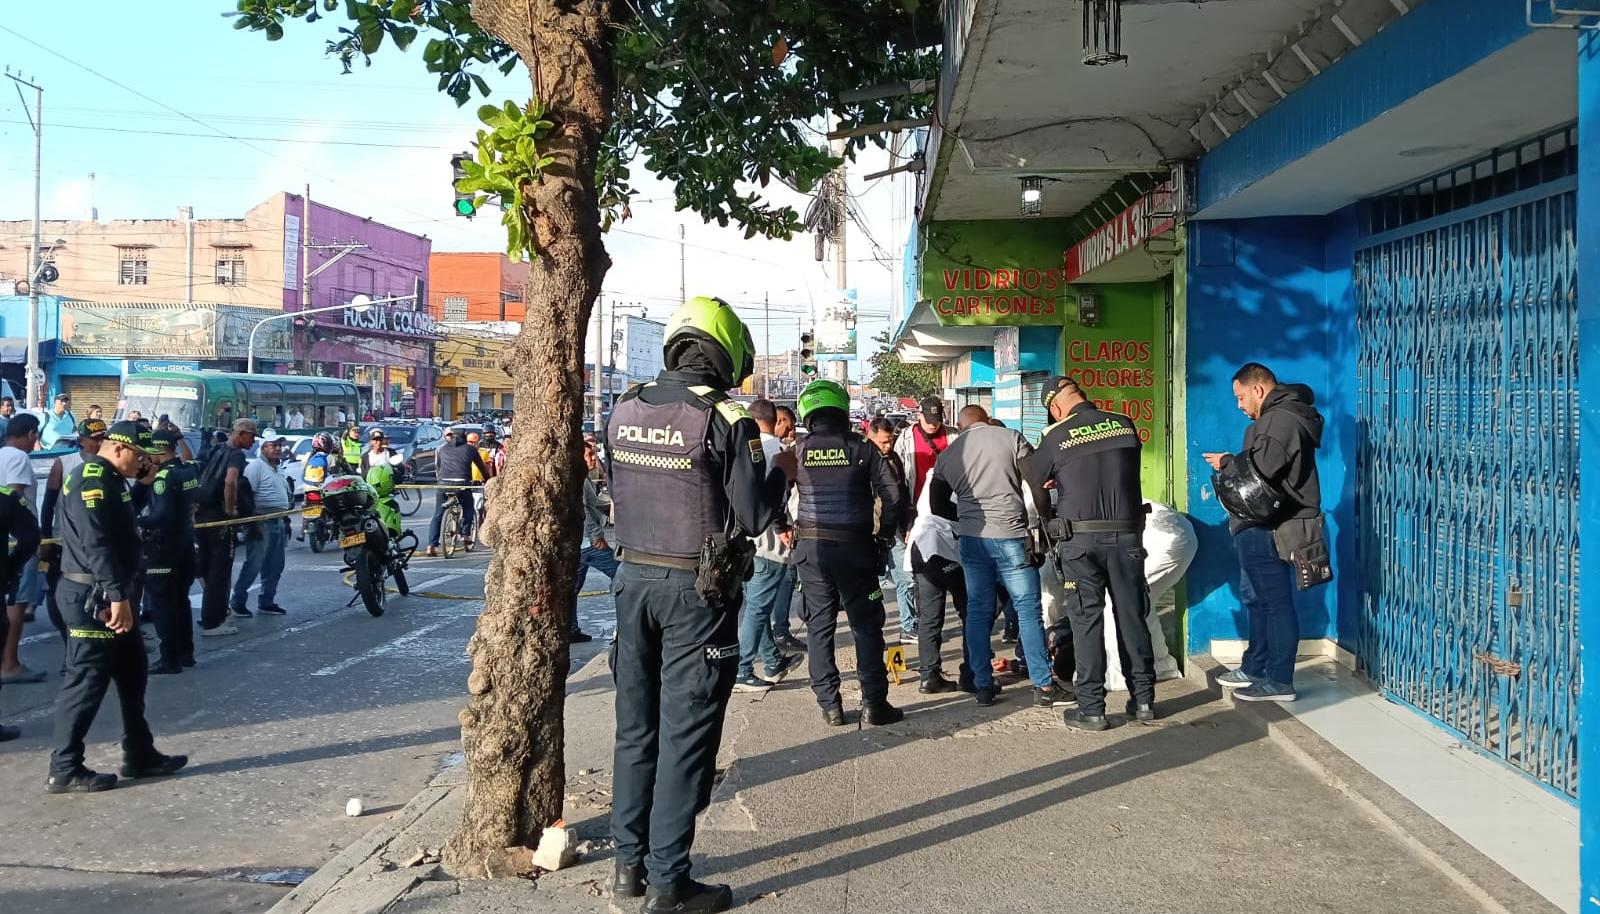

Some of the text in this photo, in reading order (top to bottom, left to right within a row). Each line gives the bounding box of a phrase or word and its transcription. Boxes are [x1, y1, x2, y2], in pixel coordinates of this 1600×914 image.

[1078, 223, 1113, 275] VIDRIOS
[1115, 212, 1128, 256] LA
[943, 268, 1059, 291] VIDRIOS
[343, 303, 387, 330] FUCSIA
[936, 296, 1056, 316] CARTONES
[106, 315, 162, 331] ANITA
[1069, 340, 1153, 363] CLAROS
[1068, 367, 1154, 388] COLORES
[616, 424, 685, 447] POLICÍA
[1068, 418, 1122, 438] POLICÍA
[806, 448, 846, 461] POLICIA
[893, 651, 903, 666] 4
